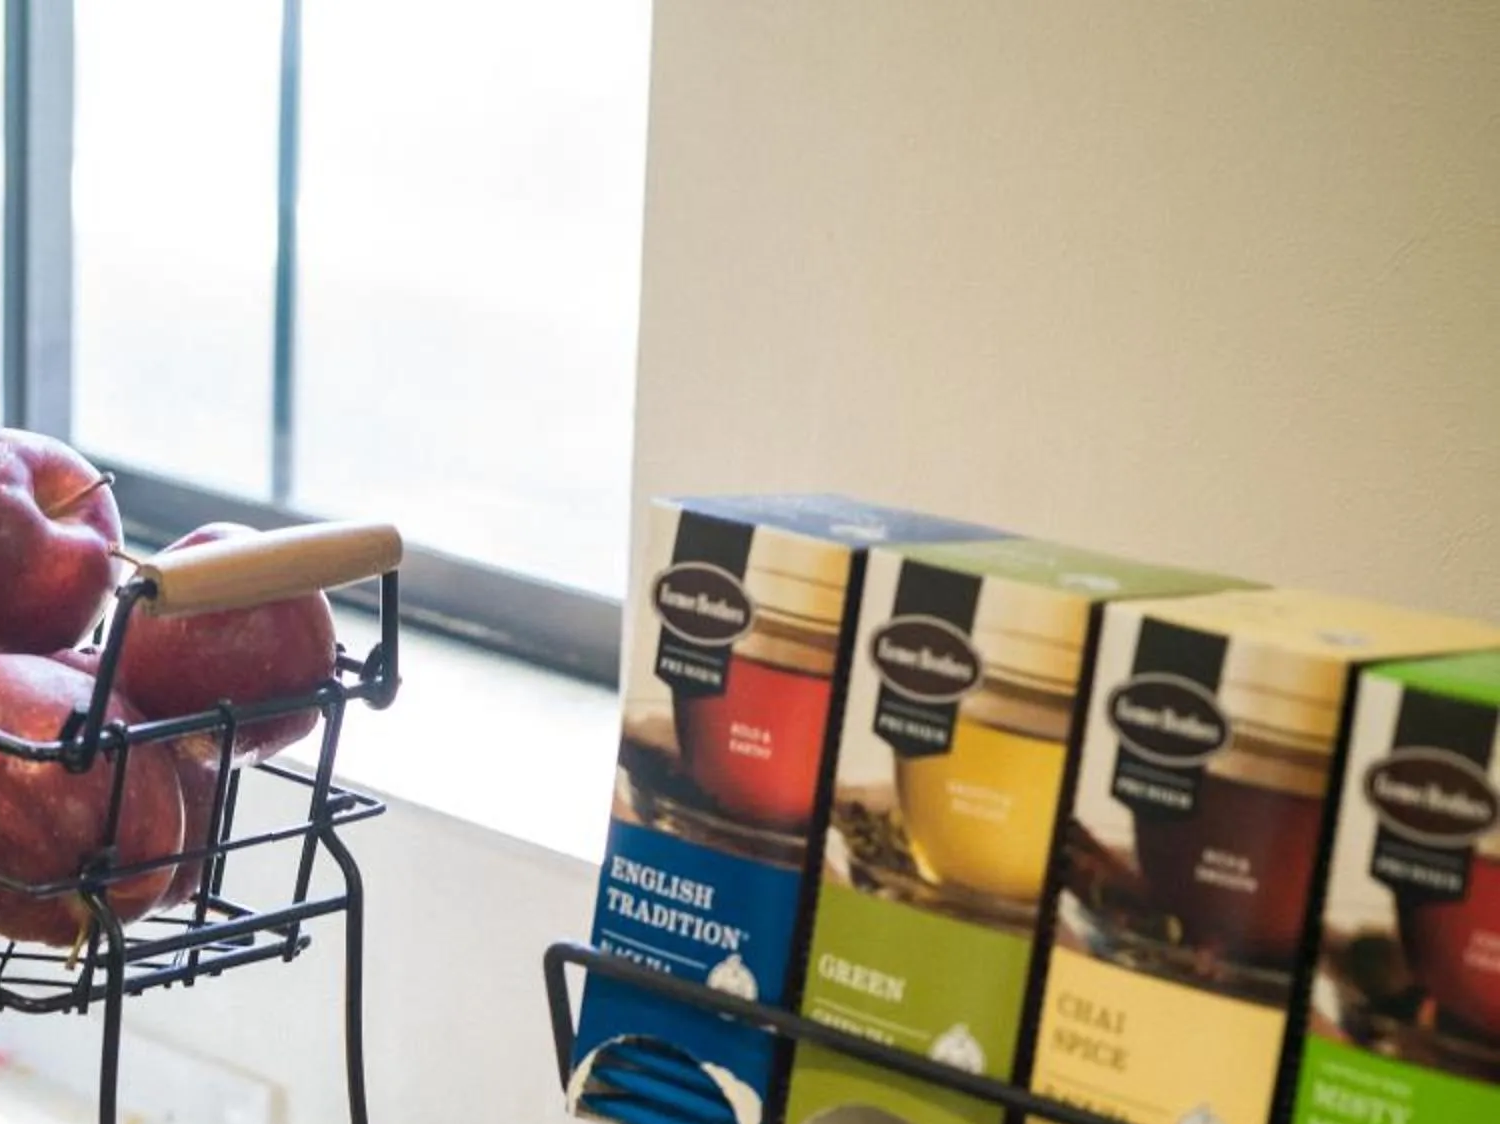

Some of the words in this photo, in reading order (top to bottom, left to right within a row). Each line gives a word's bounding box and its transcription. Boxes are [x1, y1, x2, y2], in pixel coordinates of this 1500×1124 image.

[610, 855, 715, 911] ENGLISH
[818, 953, 907, 1003] GREEN
[1056, 992, 1126, 1035] CHAI
